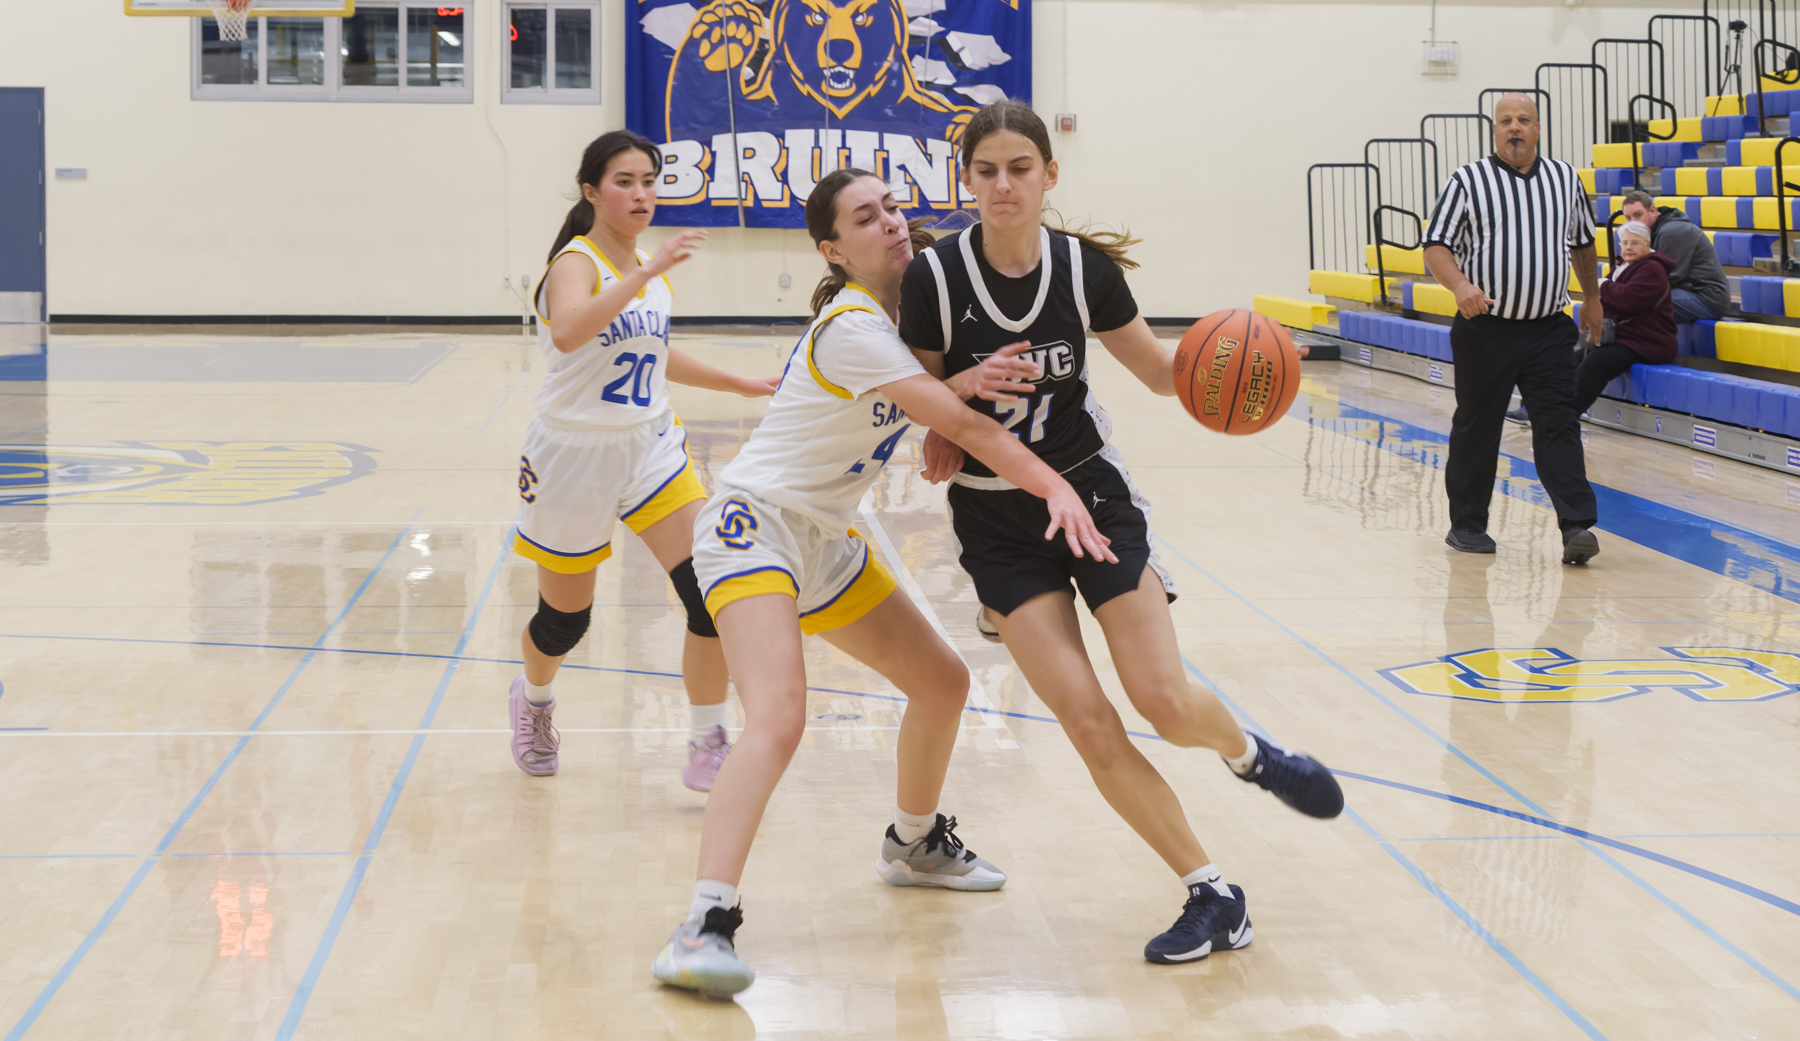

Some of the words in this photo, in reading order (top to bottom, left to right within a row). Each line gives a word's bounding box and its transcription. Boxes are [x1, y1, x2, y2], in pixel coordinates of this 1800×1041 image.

[656, 128, 978, 207] BRUIN
[601, 352, 657, 408] 20
[1203, 335, 1240, 420] SPALDING
[1236, 350, 1266, 424] LEGACY
[993, 391, 1056, 444] 21
